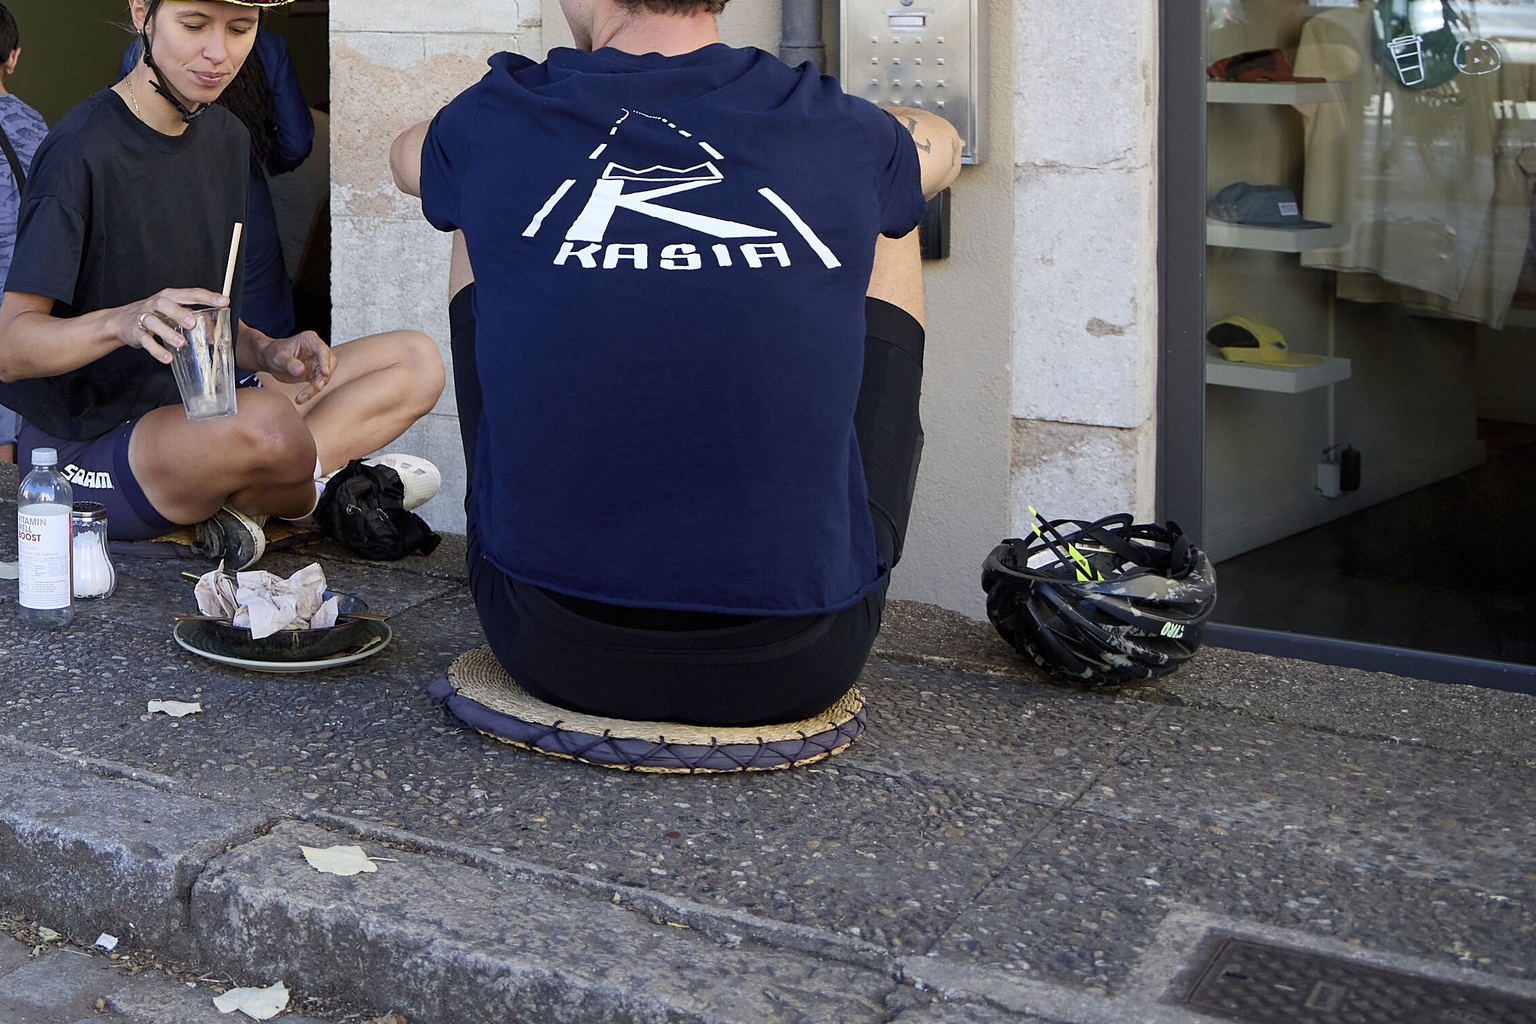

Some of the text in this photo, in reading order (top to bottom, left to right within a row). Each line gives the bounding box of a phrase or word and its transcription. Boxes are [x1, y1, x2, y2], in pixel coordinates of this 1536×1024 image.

[553, 241, 791, 270] KASIA
[60, 463, 113, 489] SRAM
[1161, 622, 1184, 640] GIRO
